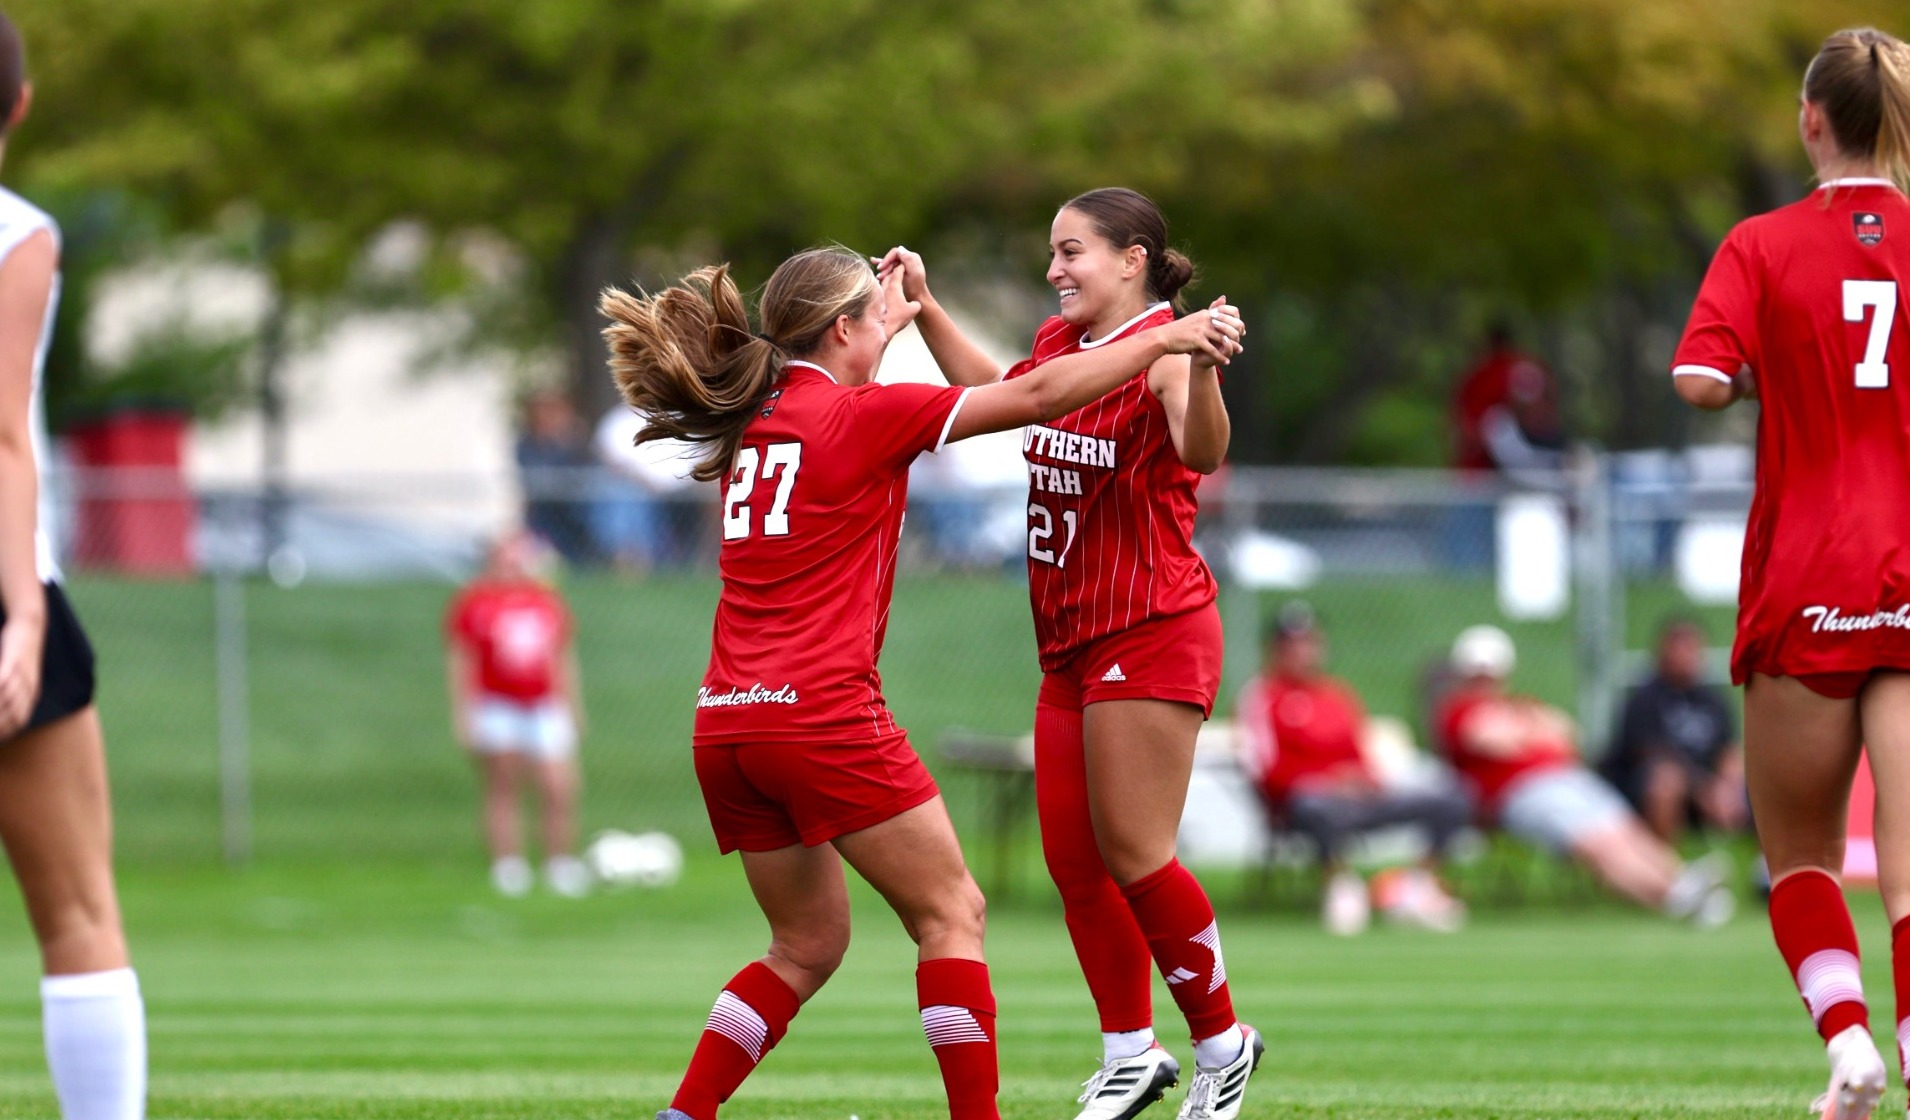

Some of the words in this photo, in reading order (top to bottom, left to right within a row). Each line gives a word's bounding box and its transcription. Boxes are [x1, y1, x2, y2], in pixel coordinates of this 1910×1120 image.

[1842, 279, 1898, 388] 7
[1024, 423, 1117, 468] UTHERN
[723, 442, 802, 540] 27
[1030, 463, 1083, 495] TAH
[1028, 502, 1077, 568] 21
[696, 682, 799, 709] Thunderbirds
